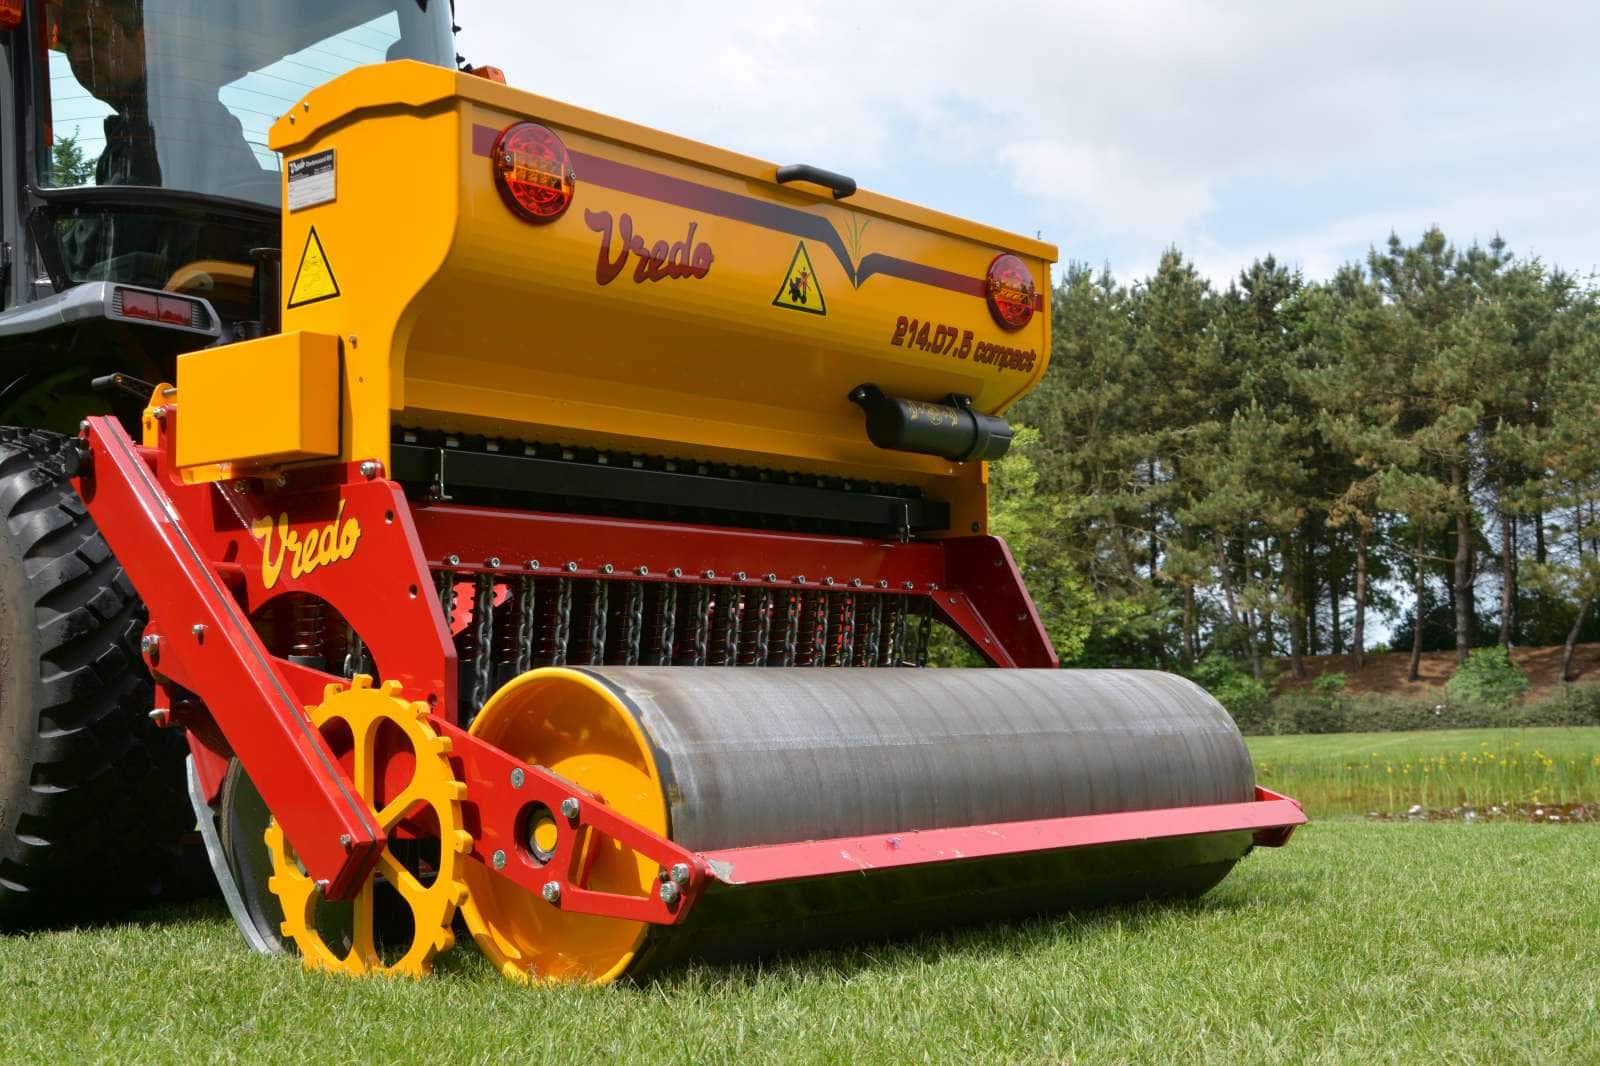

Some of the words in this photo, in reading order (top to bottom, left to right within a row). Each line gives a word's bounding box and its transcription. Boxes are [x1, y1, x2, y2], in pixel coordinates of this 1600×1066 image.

[583, 207, 715, 286] Vredo
[972, 340, 1037, 373] compact
[251, 498, 361, 590] Vredo
